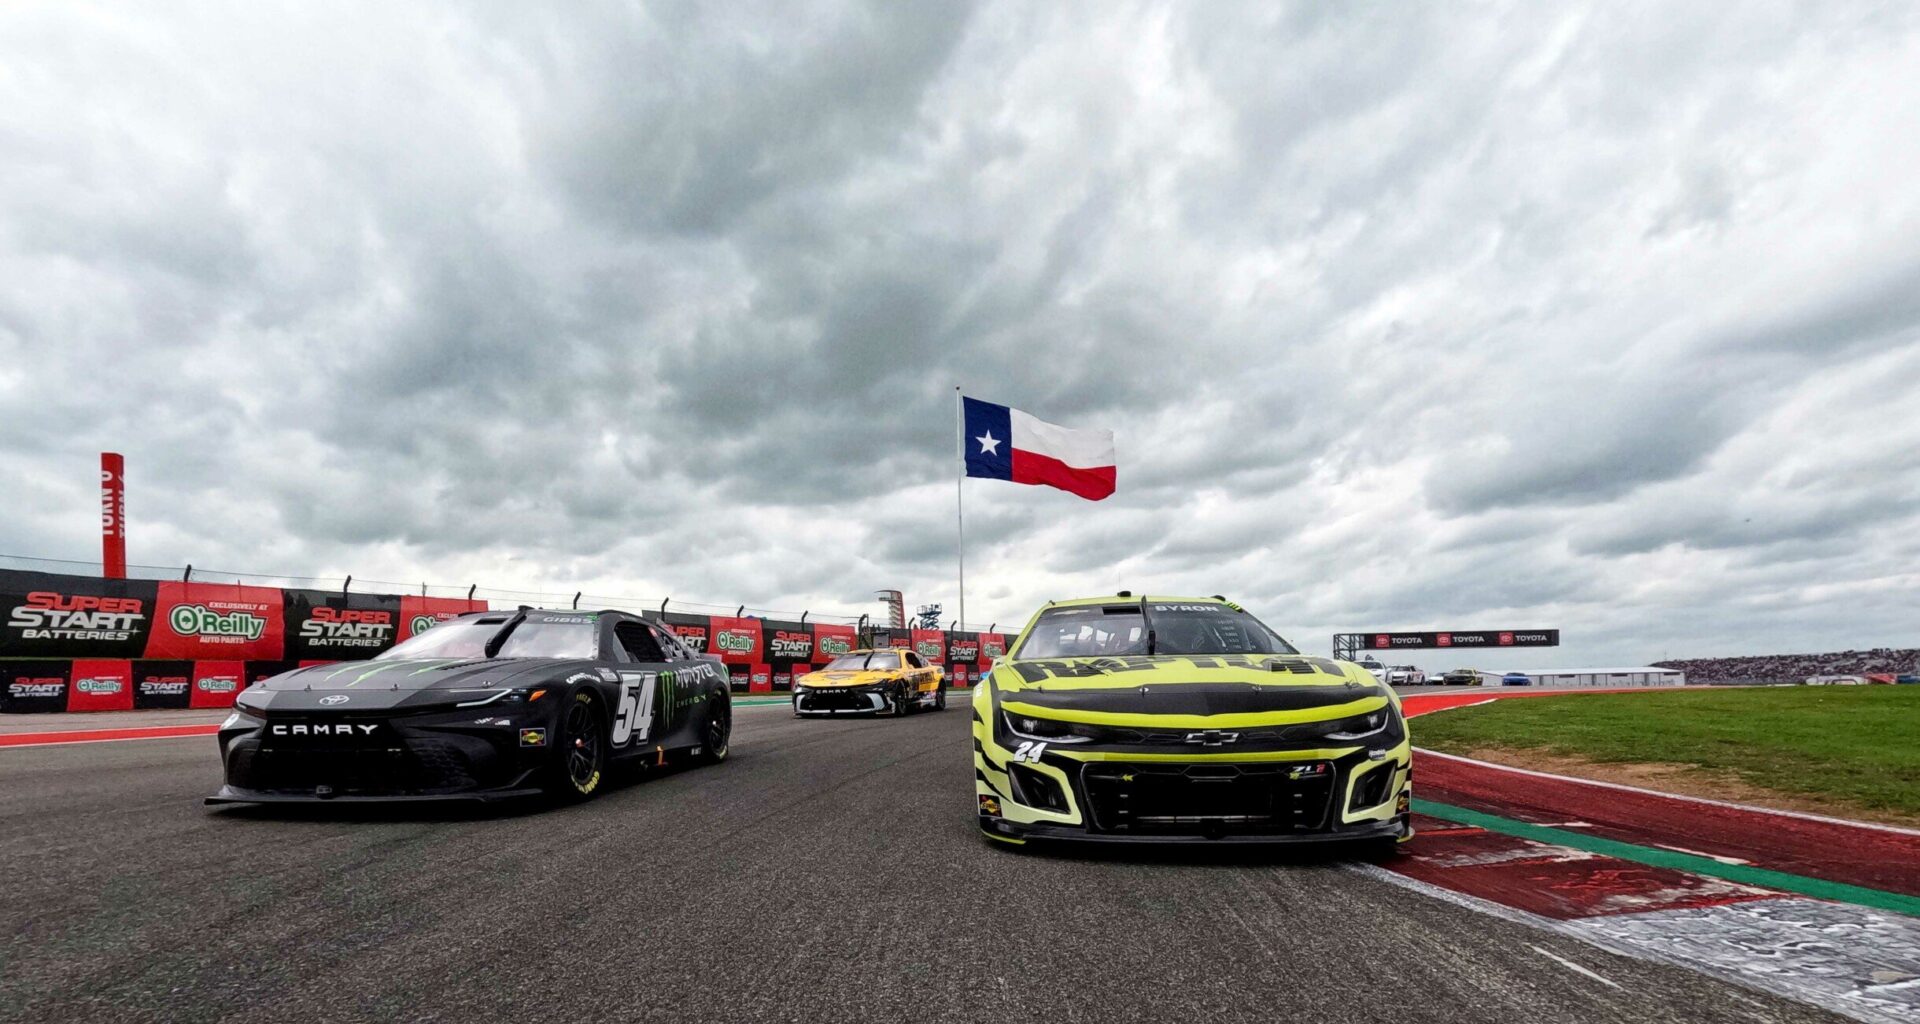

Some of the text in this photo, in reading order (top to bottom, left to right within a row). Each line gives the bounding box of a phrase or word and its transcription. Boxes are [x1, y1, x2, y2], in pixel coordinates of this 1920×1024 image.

[26, 591, 143, 614] SUPER
[208, 601, 269, 611] EXCLUSIVELY AT
[1154, 604, 1220, 612] BYRON
[8, 605, 146, 628] START
[169, 603, 267, 640] O'Reilly
[311, 607, 392, 625] SUPER
[299, 618, 394, 638] START
[22, 629, 131, 641] BATTERIES
[199, 636, 245, 645] AUTO PARTS
[775, 630, 811, 642] SUPER
[1391, 637, 1423, 645] TOYOTA
[1515, 634, 1548, 642] TOYOTA
[308, 637, 382, 648] BATTERIES
[717, 631, 754, 653] O'Reilly
[770, 639, 813, 652] START
[949, 646, 979, 656] START
[8, 683, 65, 693] START
[139, 682, 189, 691] START
[611, 673, 656, 745] 54
[272, 724, 379, 735] CAMRY
[1013, 741, 1048, 764] 24
